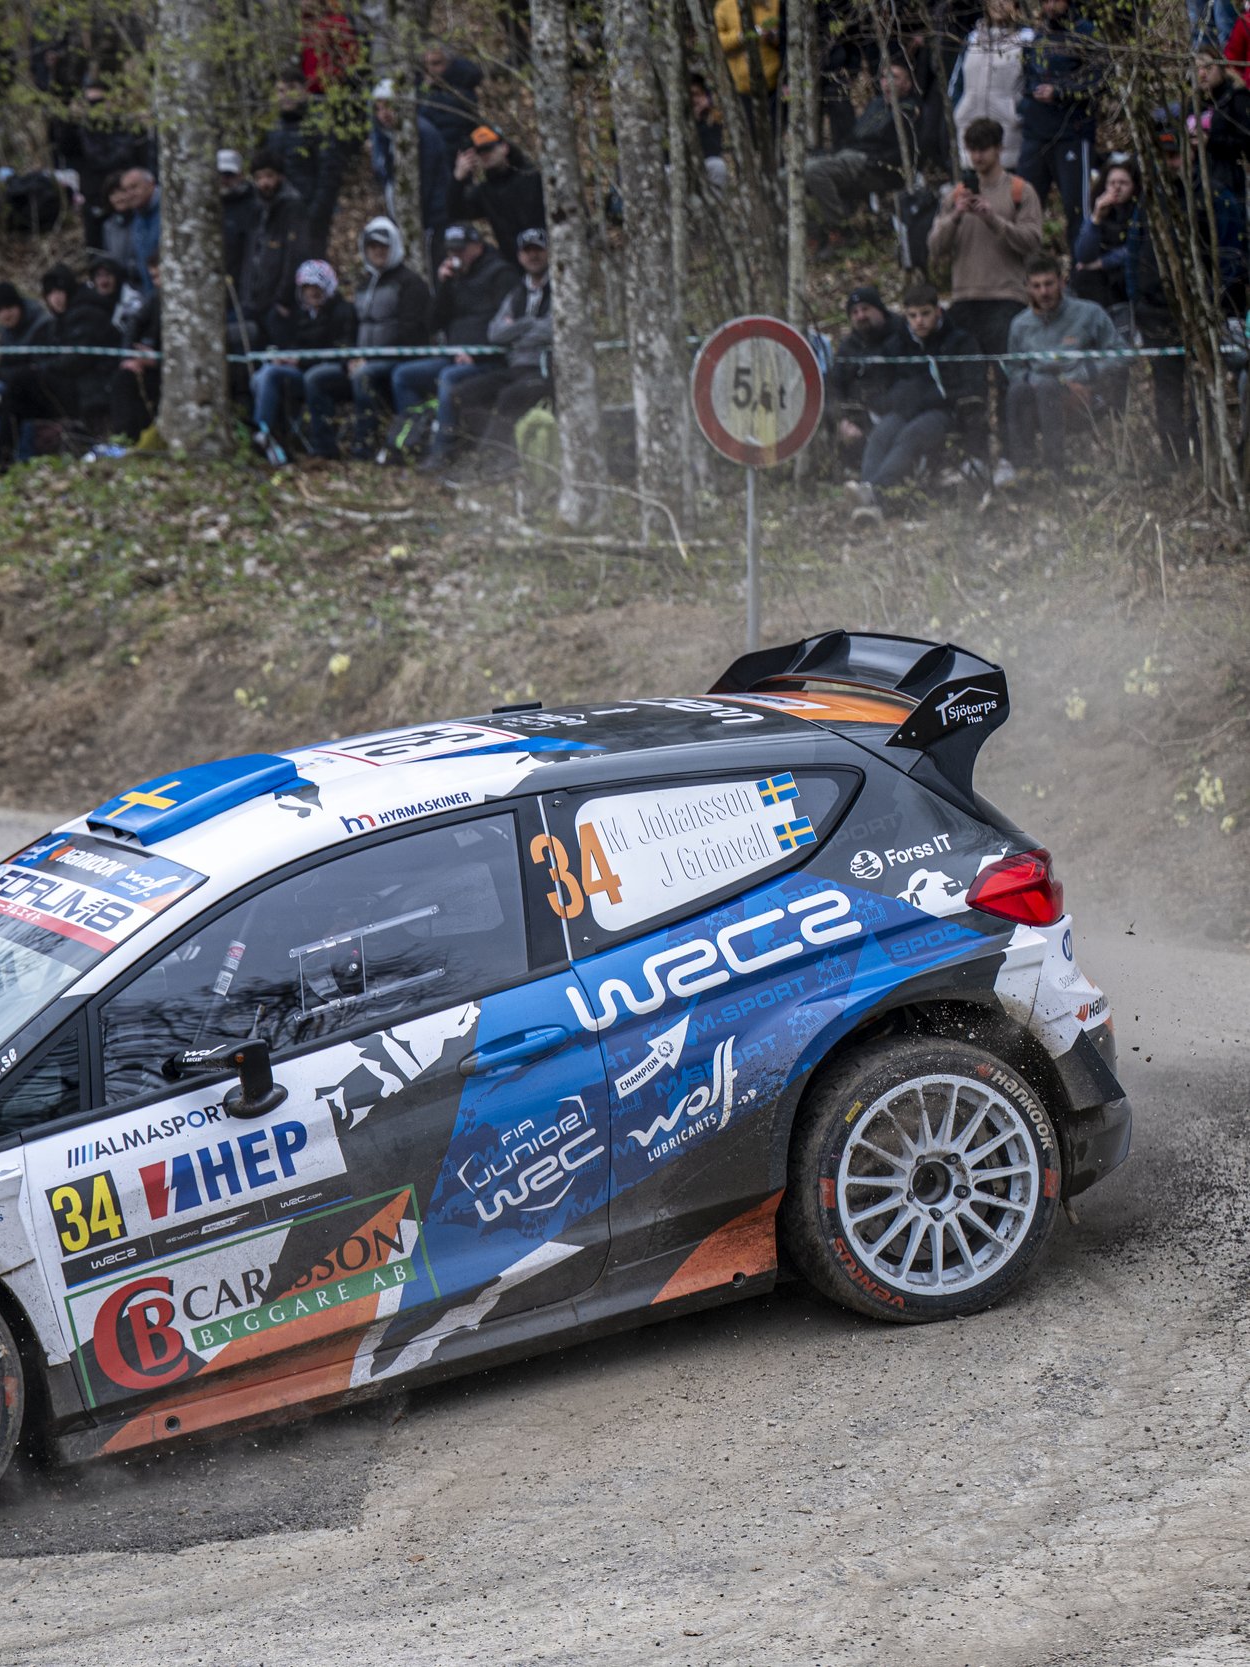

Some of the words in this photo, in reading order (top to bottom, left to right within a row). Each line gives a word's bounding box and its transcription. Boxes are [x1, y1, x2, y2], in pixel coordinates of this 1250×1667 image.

[947, 699, 997, 721] Sjötorps
[967, 714, 983, 725] Hus
[378, 791, 472, 824] HYRMASKINER
[638, 785, 756, 845] Johansson
[530, 821, 623, 919] 34
[677, 822, 774, 880] Grönvall
[884, 842, 935, 867] Forss
[933, 833, 952, 853] IT
[565, 890, 862, 1031] WRC2
[619, 1056, 660, 1091] CHAMPION
[196, 1119, 308, 1202] HEP
[474, 1112, 582, 1188] JUNIOR
[501, 1119, 535, 1146] FIA
[647, 1112, 717, 1162] LUBRICANTS
[474, 1127, 605, 1222] WRC
[52, 1174, 122, 1253] 34
[90, 1247, 137, 1270] WRC2
[200, 1283, 350, 1346] BYGGARE
